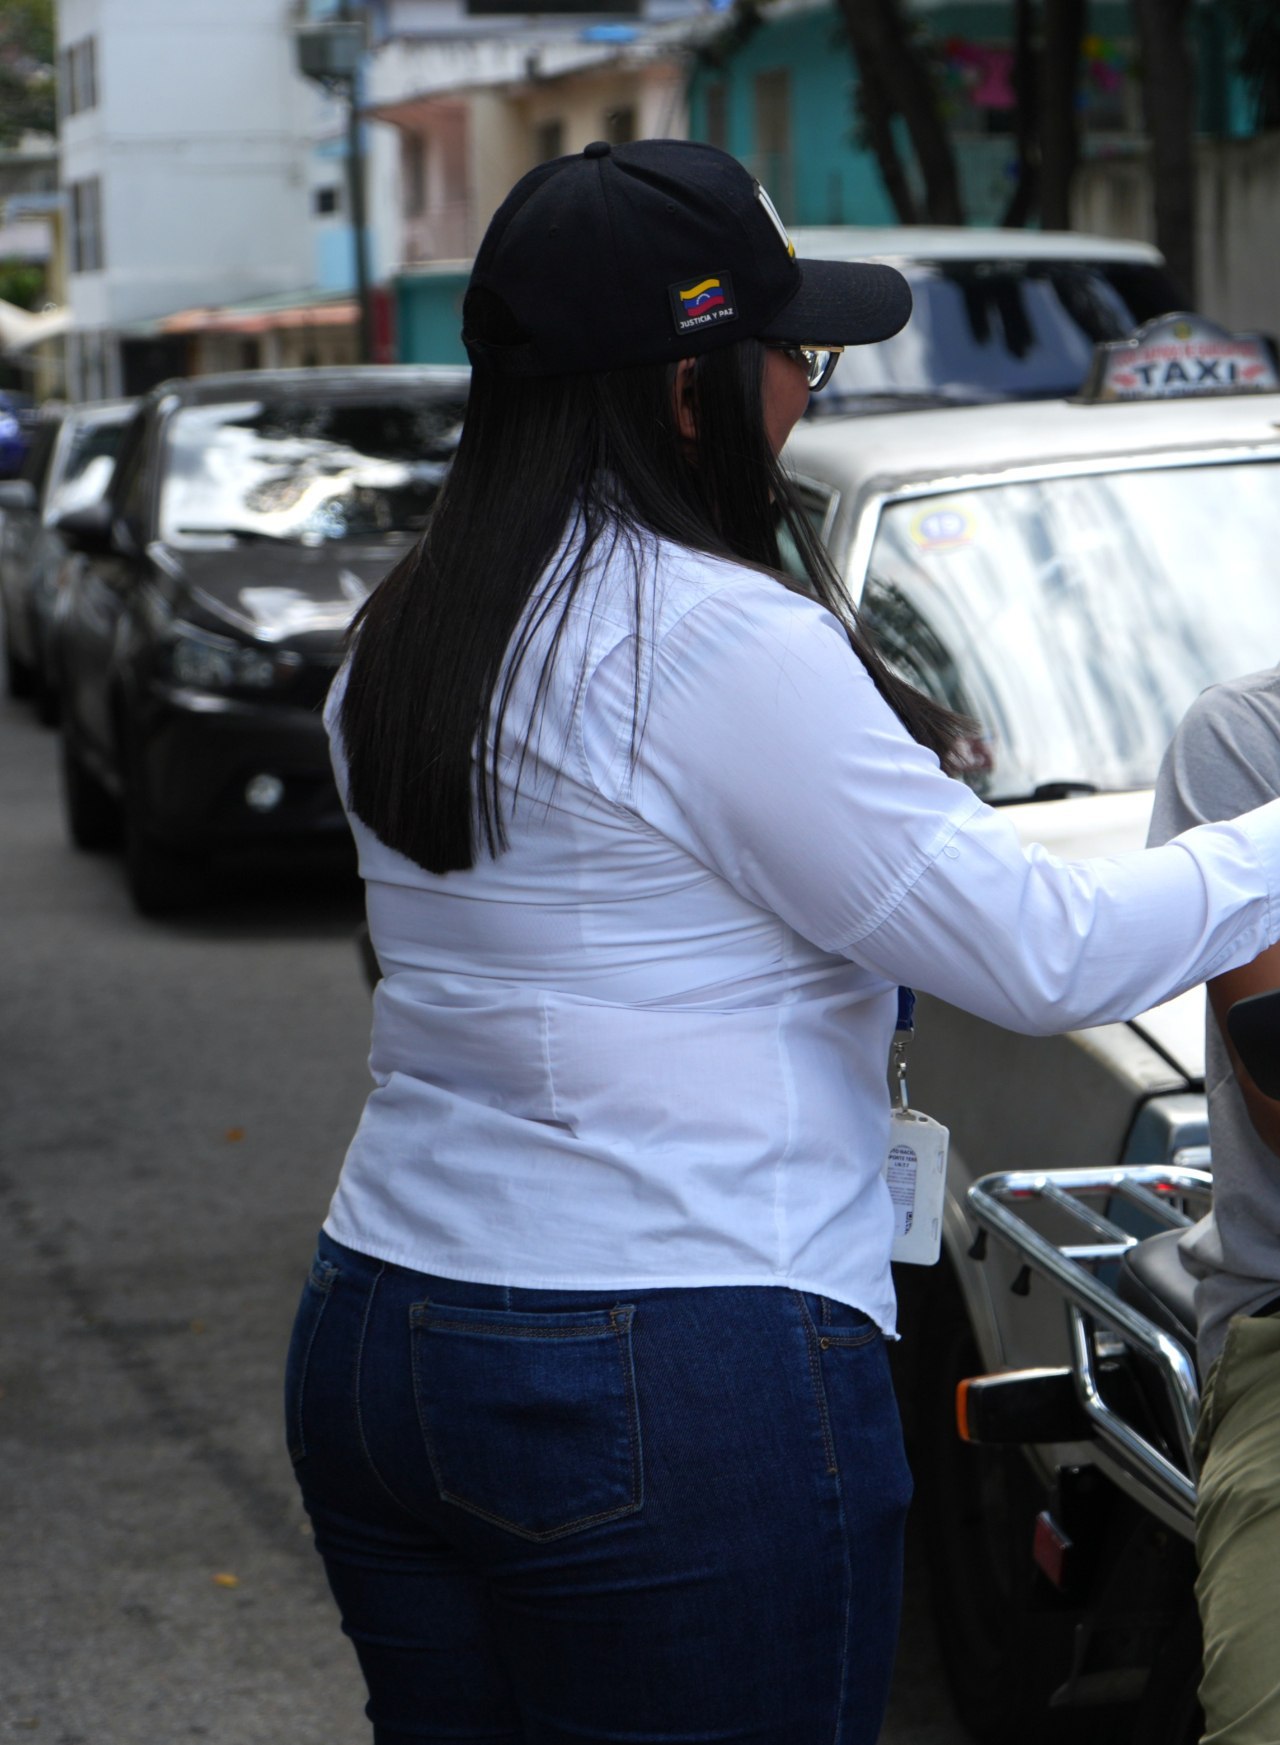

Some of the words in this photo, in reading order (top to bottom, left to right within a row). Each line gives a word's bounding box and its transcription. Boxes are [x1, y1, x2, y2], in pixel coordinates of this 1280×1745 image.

[679, 314, 712, 329] JUSTICIA
[712, 312, 718, 320] Y
[719, 307, 734, 318] PAZ
[1133, 357, 1237, 384] TAXI
